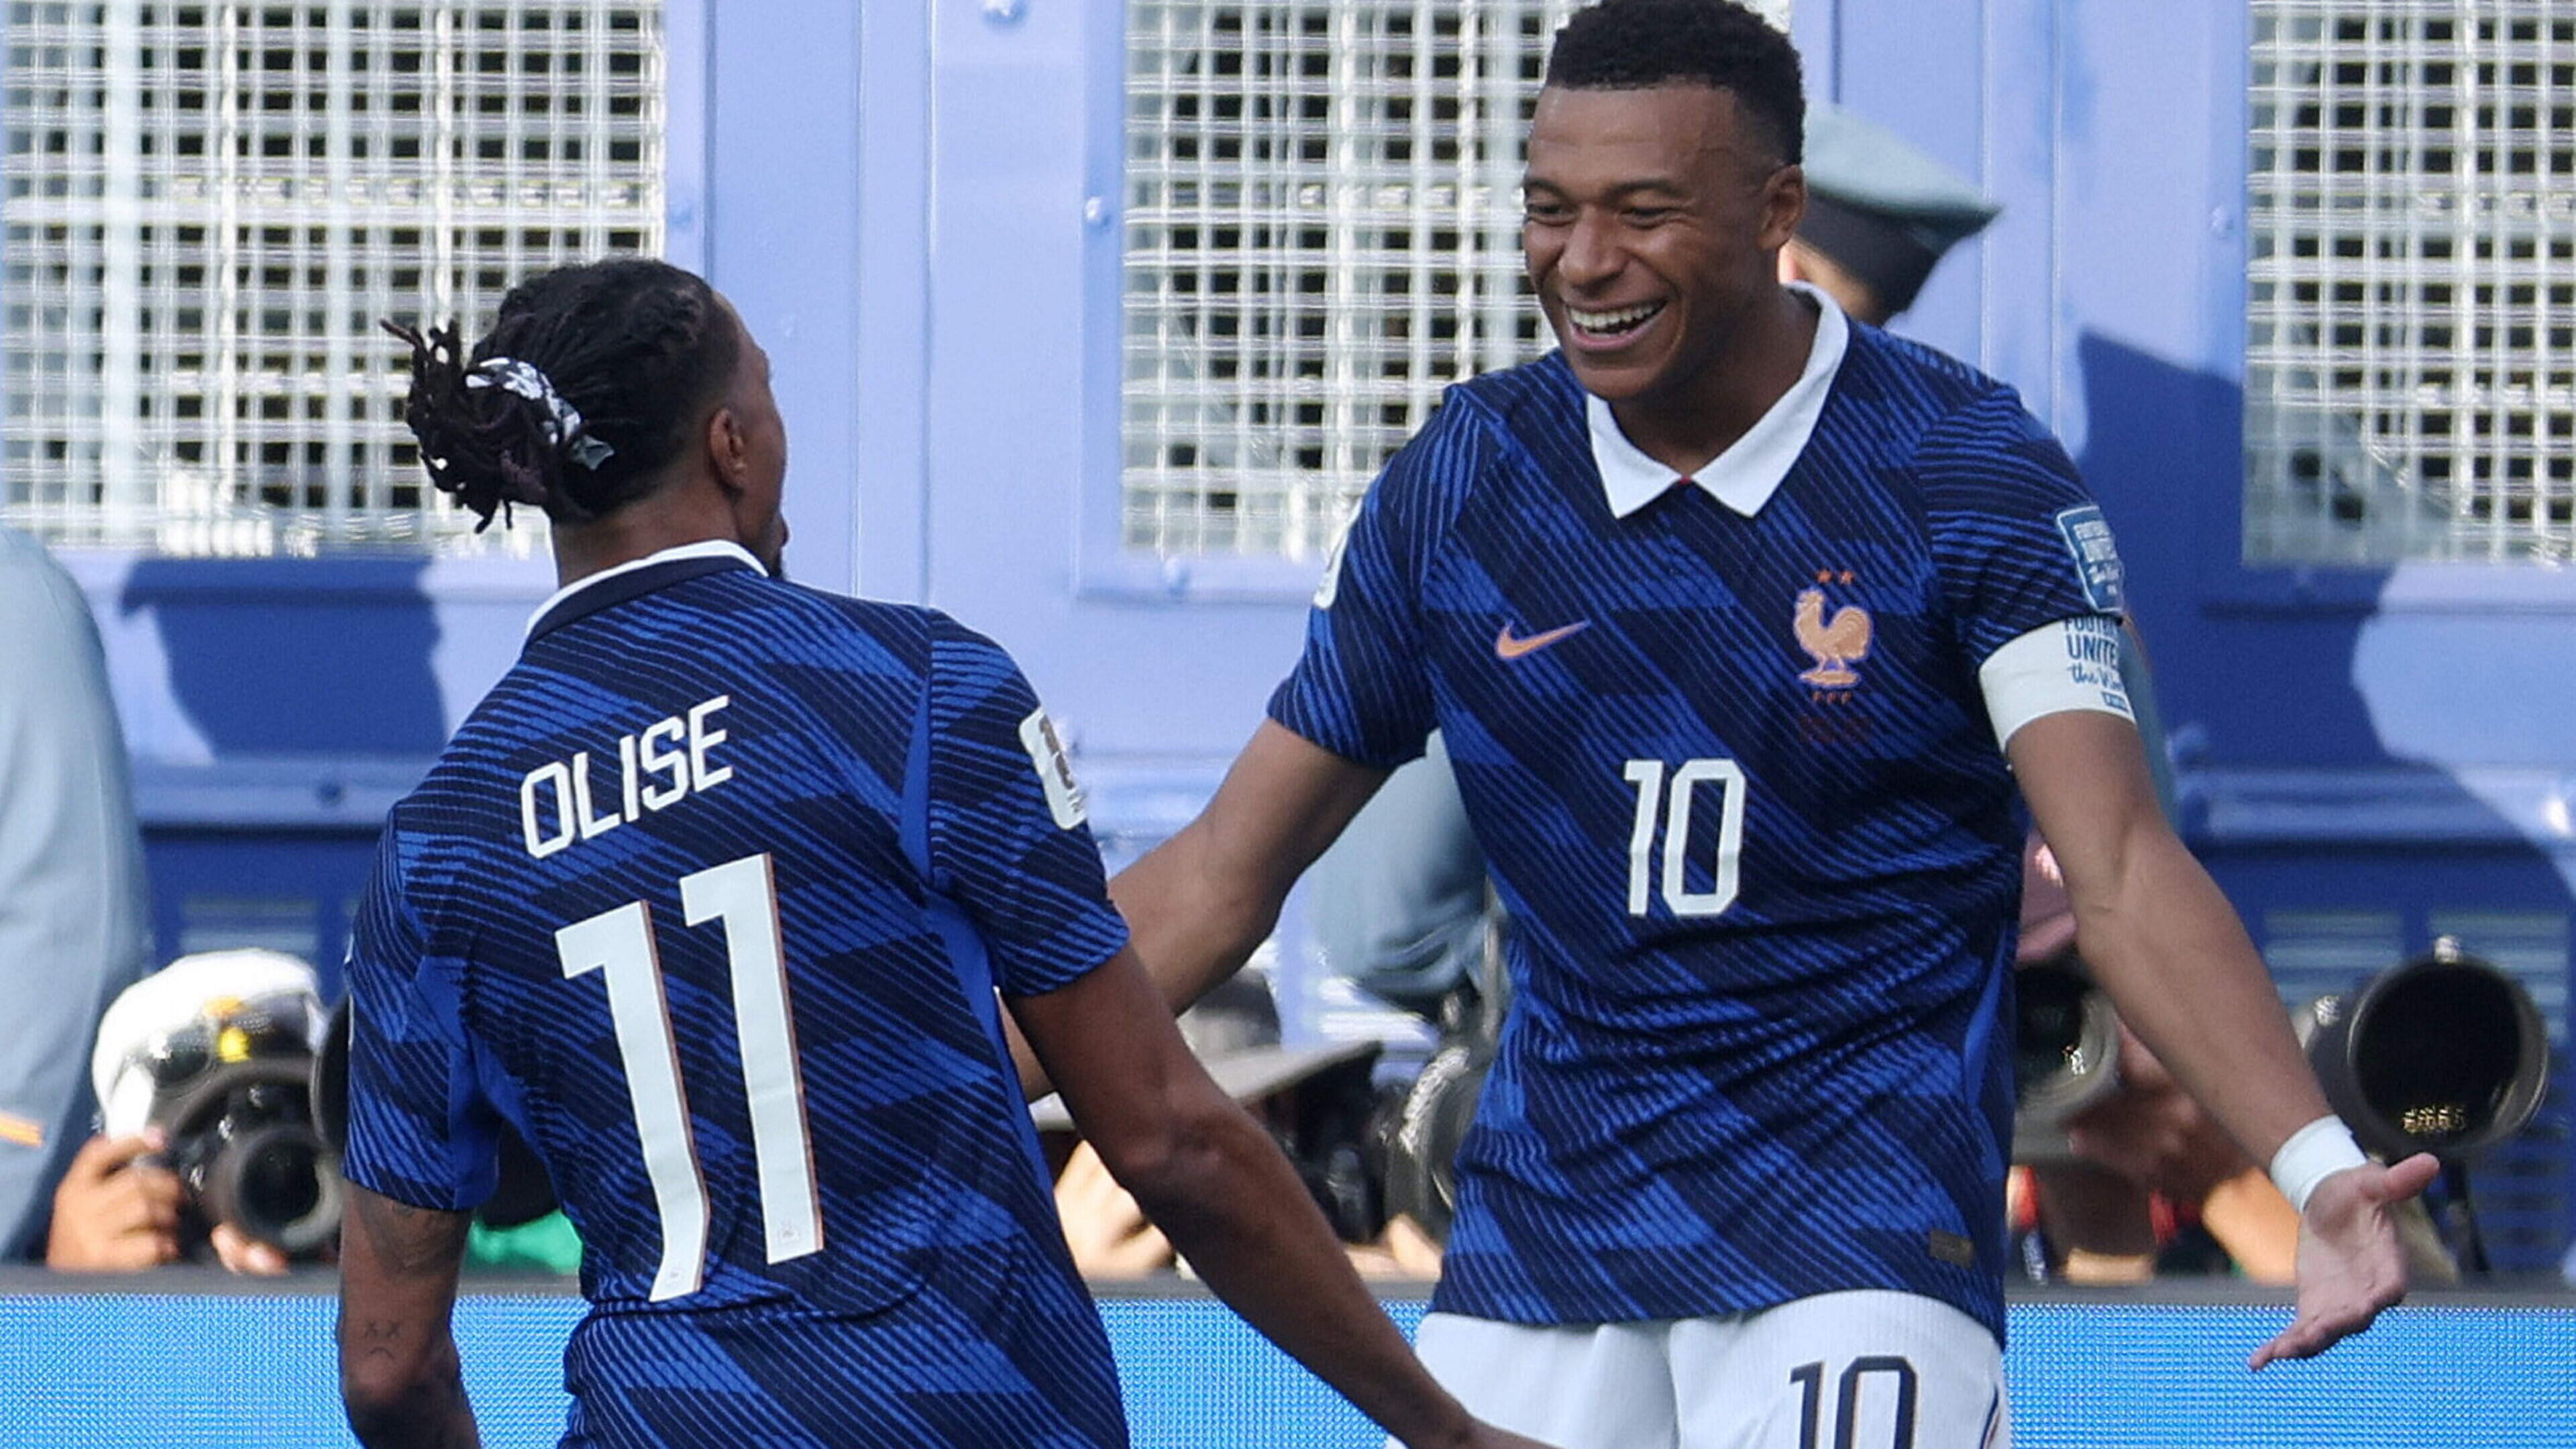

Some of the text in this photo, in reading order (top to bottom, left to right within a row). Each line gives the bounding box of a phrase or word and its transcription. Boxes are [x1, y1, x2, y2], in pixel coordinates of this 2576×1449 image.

[521, 695, 733, 859] OLISE
[1624, 759, 1746, 916] 10
[554, 853, 824, 1303] 11
[1790, 1355, 1917, 1449] 10
